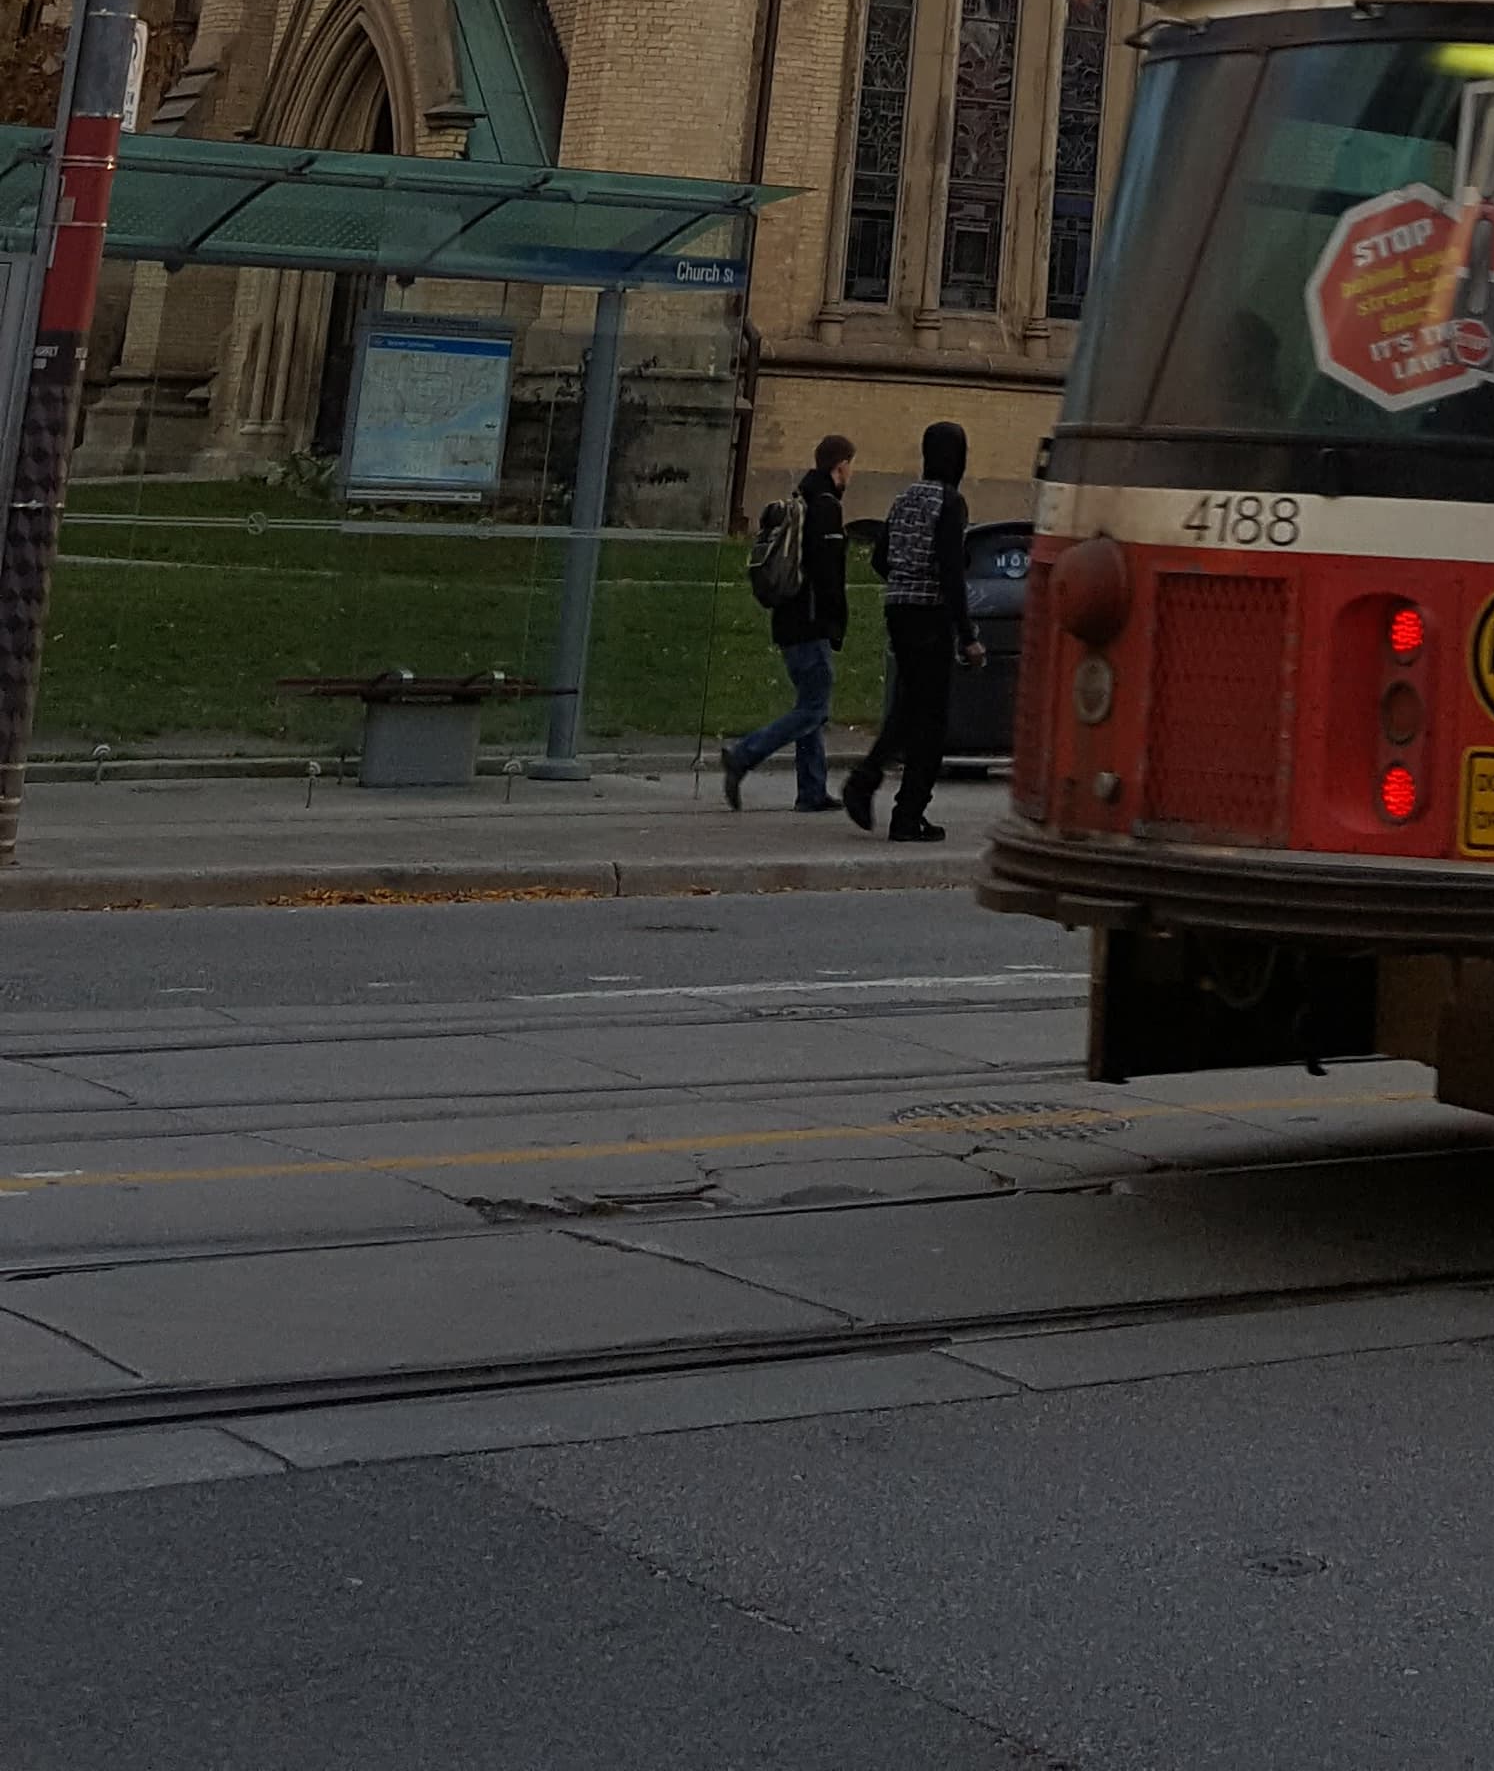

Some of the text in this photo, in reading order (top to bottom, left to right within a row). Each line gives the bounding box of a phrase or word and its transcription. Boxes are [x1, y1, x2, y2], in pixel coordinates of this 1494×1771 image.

[1354, 218, 1433, 267] STOP
[676, 260, 720, 283] Church
[1182, 496, 1300, 547] 4188
